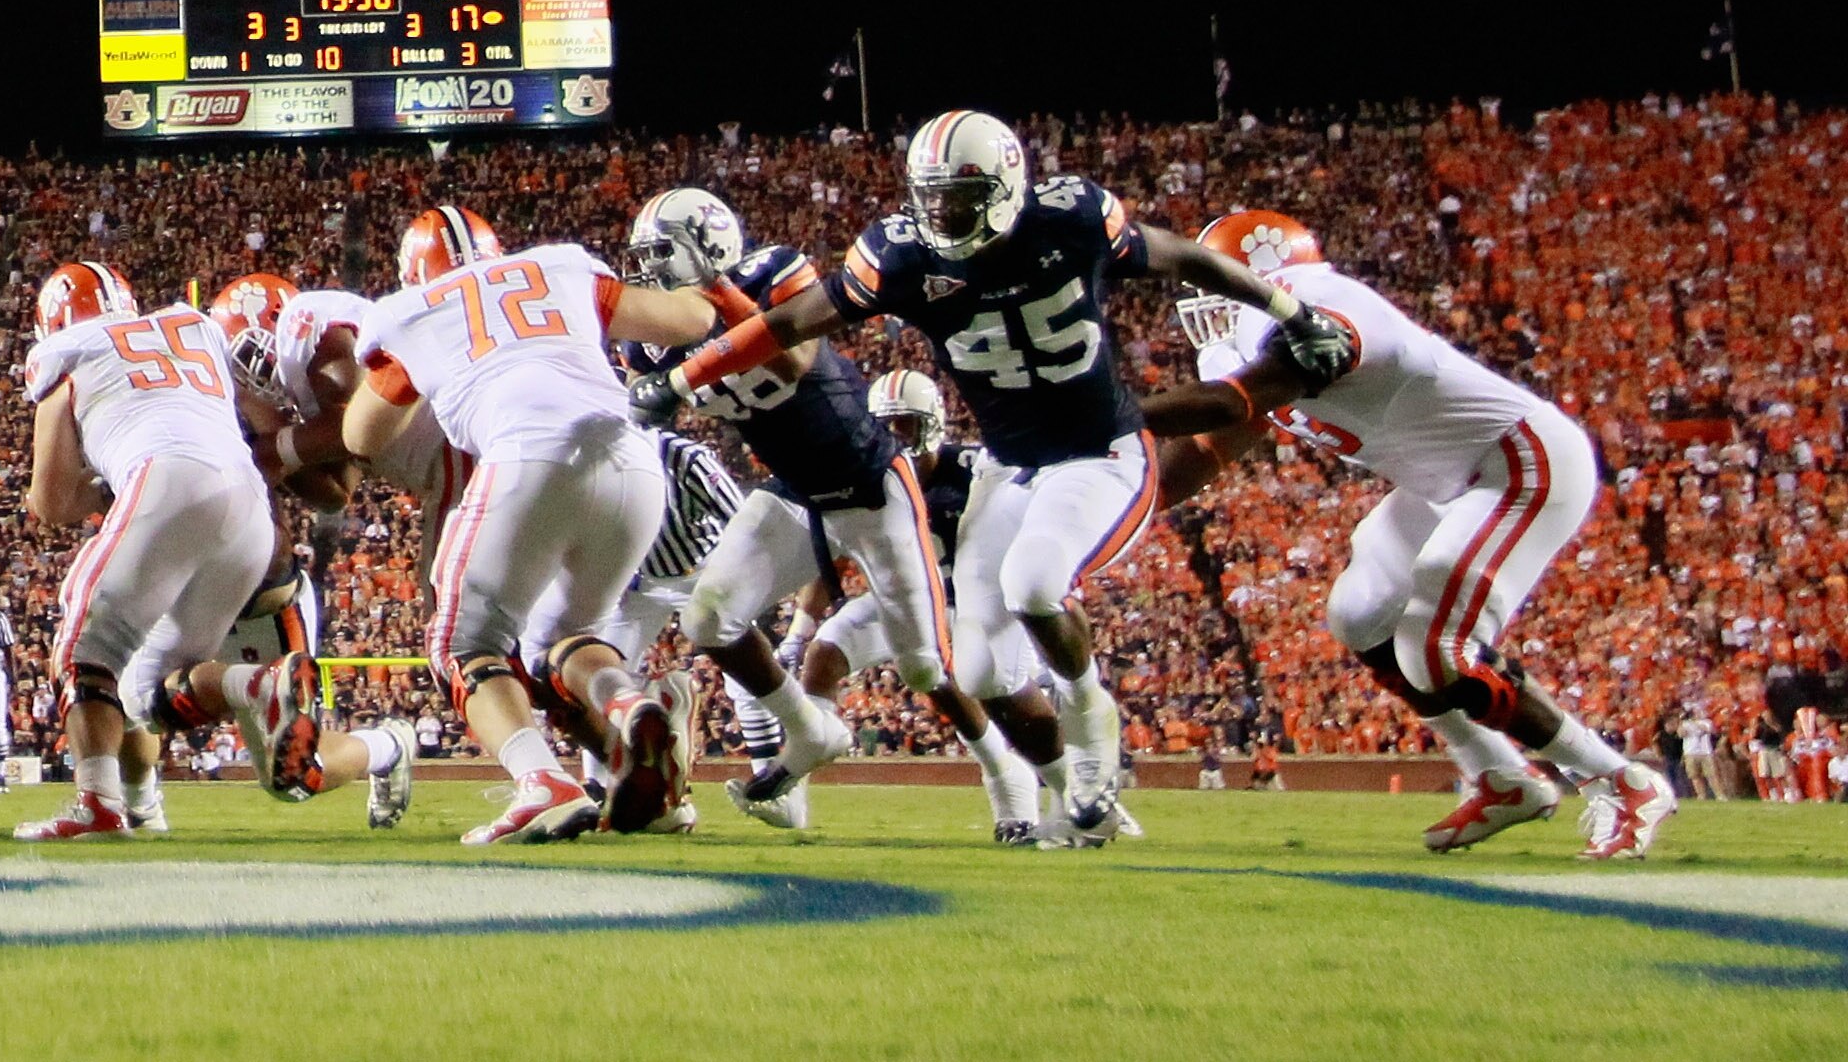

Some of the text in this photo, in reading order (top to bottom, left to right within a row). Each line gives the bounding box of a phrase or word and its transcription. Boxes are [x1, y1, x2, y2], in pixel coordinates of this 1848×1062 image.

[247, 11, 266, 40] 3
[285, 17, 300, 42] 3
[406, 13, 423, 38] 3
[451, 5, 480, 32] 17
[104, 50, 177, 62] YellaWood
[240, 51, 250, 72] 1
[266, 54, 282, 68] TO
[316, 46, 342, 70] 10
[392, 46, 401, 67] 1
[461, 42, 477, 66] 3
[263, 86, 347, 98] THE FLAVOR
[400, 77, 514, 110] FOX 20
[170, 93, 240, 122] Bryan
[281, 99, 330, 110] OF THE
[276, 112, 338, 124] SOUTH!
[423, 258, 570, 363] 72
[945, 276, 1102, 389] 45
[103, 312, 226, 399] 55
